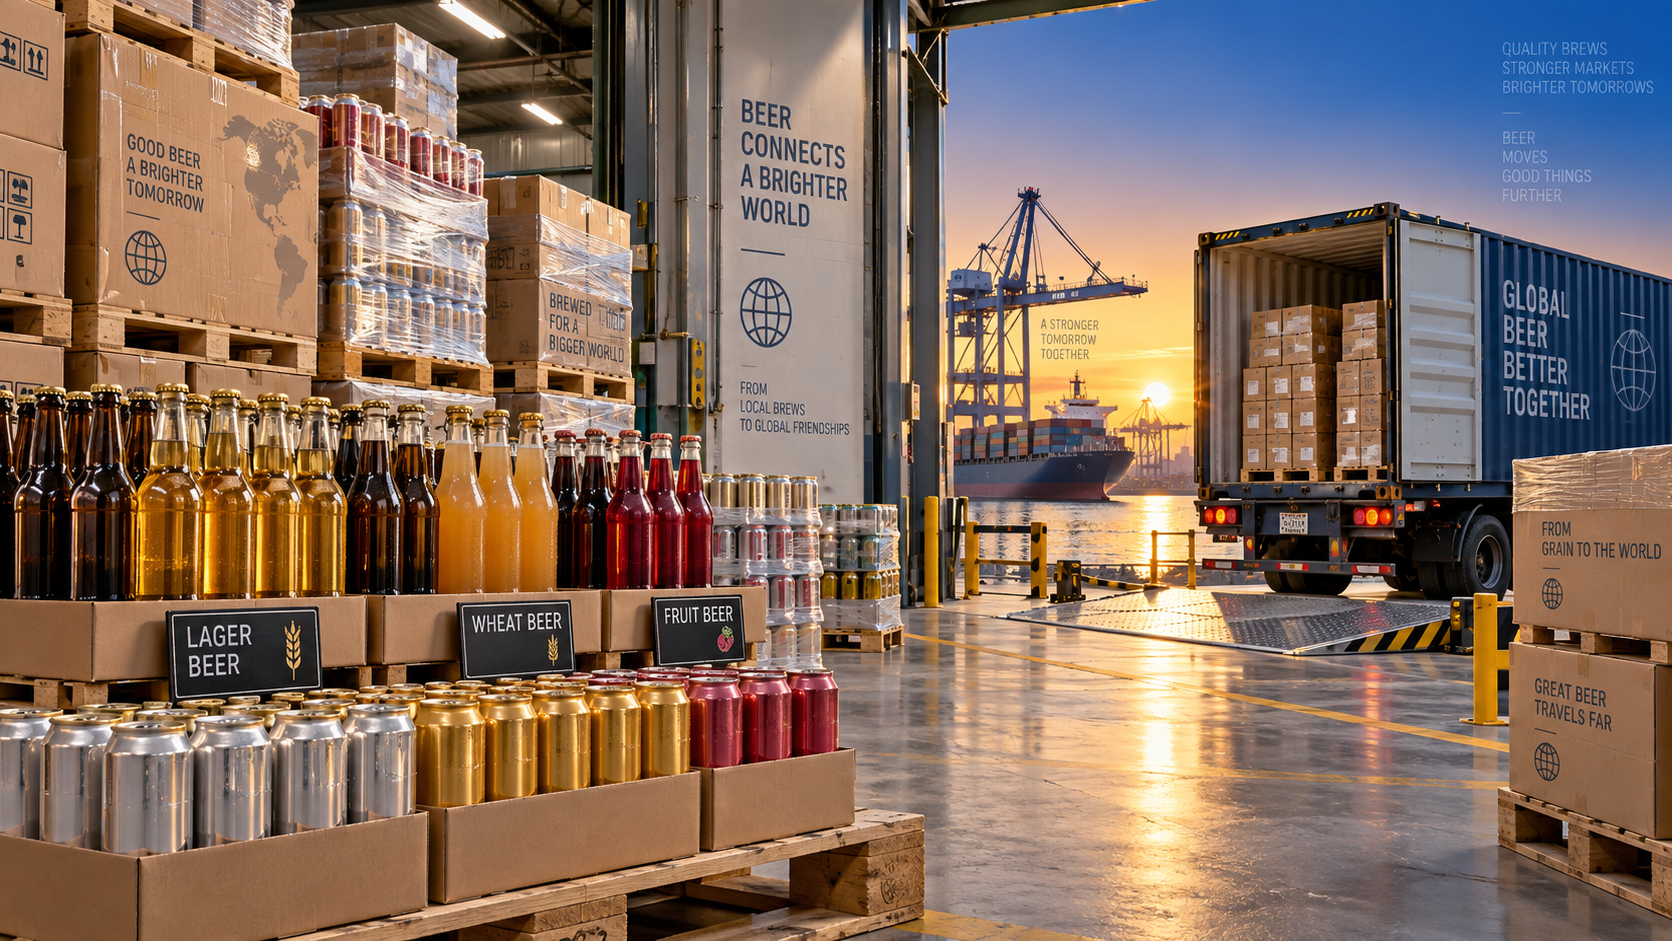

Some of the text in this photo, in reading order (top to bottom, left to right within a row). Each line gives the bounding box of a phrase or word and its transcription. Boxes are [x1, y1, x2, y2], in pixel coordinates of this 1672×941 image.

[741, 98, 792, 131] BEER
[127, 133, 201, 169] GOOD BEER
[741, 131, 846, 170] CONNECTS
[126, 157, 203, 192] A BRIGHTER
[741, 163, 848, 202] A BRIGHTER
[126, 178, 204, 213] TOMORROW
[741, 196, 811, 228] WORLD
[549, 292, 592, 316] BREWED
[1502, 279, 1570, 319] GLOBAL
[549, 313, 579, 335] FOR A
[1503, 315, 1548, 349] BEER
[549, 335, 585, 356] BIGGER
[1503, 350, 1568, 386] BETTER
[740, 381, 768, 396] FROM
[1503, 385, 1591, 421] TOGETHER
[740, 400, 805, 417] LOCAL BREWS
[740, 418, 850, 436] TO GLOBAL FRIENDSHIPS
[1542, 521, 1571, 537] FROM
[1542, 541, 1662, 560] GRAIN TO THE WORLD
[471, 611, 563, 634] WHEAT BEER
[663, 604, 734, 625] FRUIT BEER
[187, 624, 252, 648] LAGER
[189, 654, 240, 677] BEER
[1534, 677, 1607, 708] GREAT BEER
[1534, 699, 1612, 732] TRAVELS FAR
